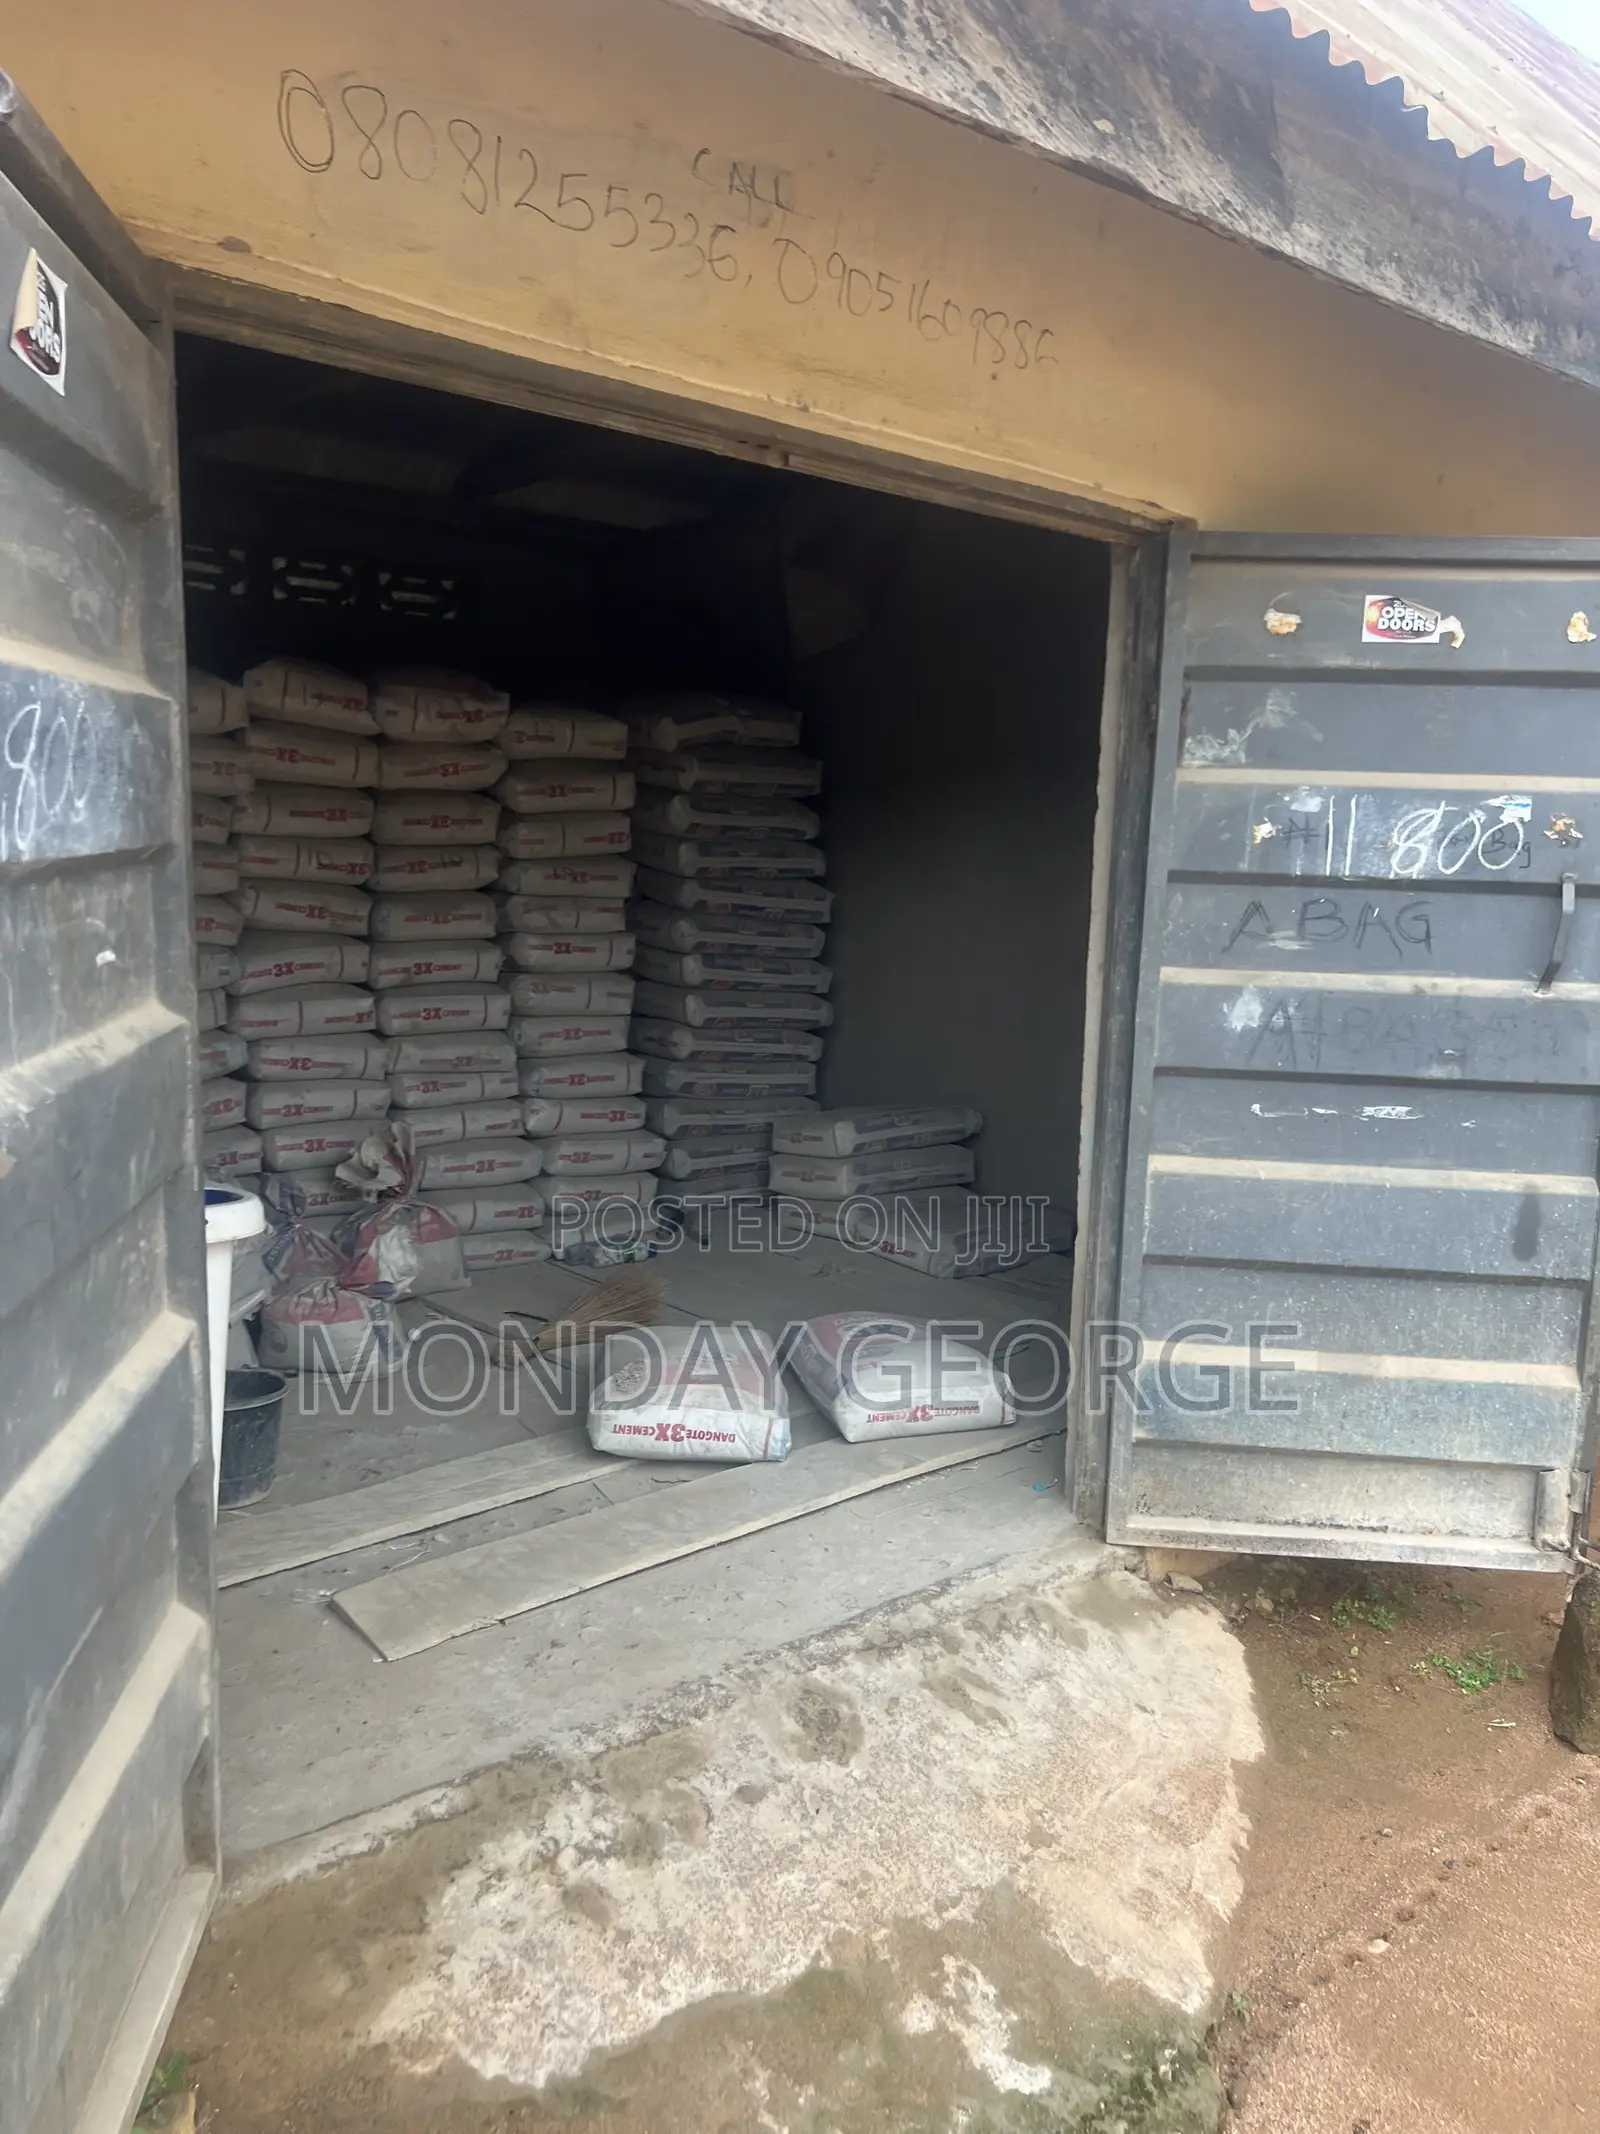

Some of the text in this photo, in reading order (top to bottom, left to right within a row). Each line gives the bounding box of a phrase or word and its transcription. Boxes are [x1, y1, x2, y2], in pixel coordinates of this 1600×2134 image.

[1377, 618, 1436, 632] DOORS
[1220, 899, 1435, 956] A BAG
[413, 962, 433, 975] 3X
[422, 1008, 442, 1020] 3X
[866, 1411, 907, 1423] CEMENT
[906, 1404, 935, 1422] 3X
[612, 1423, 736, 1443] DANGOTE 3X CEMENT
